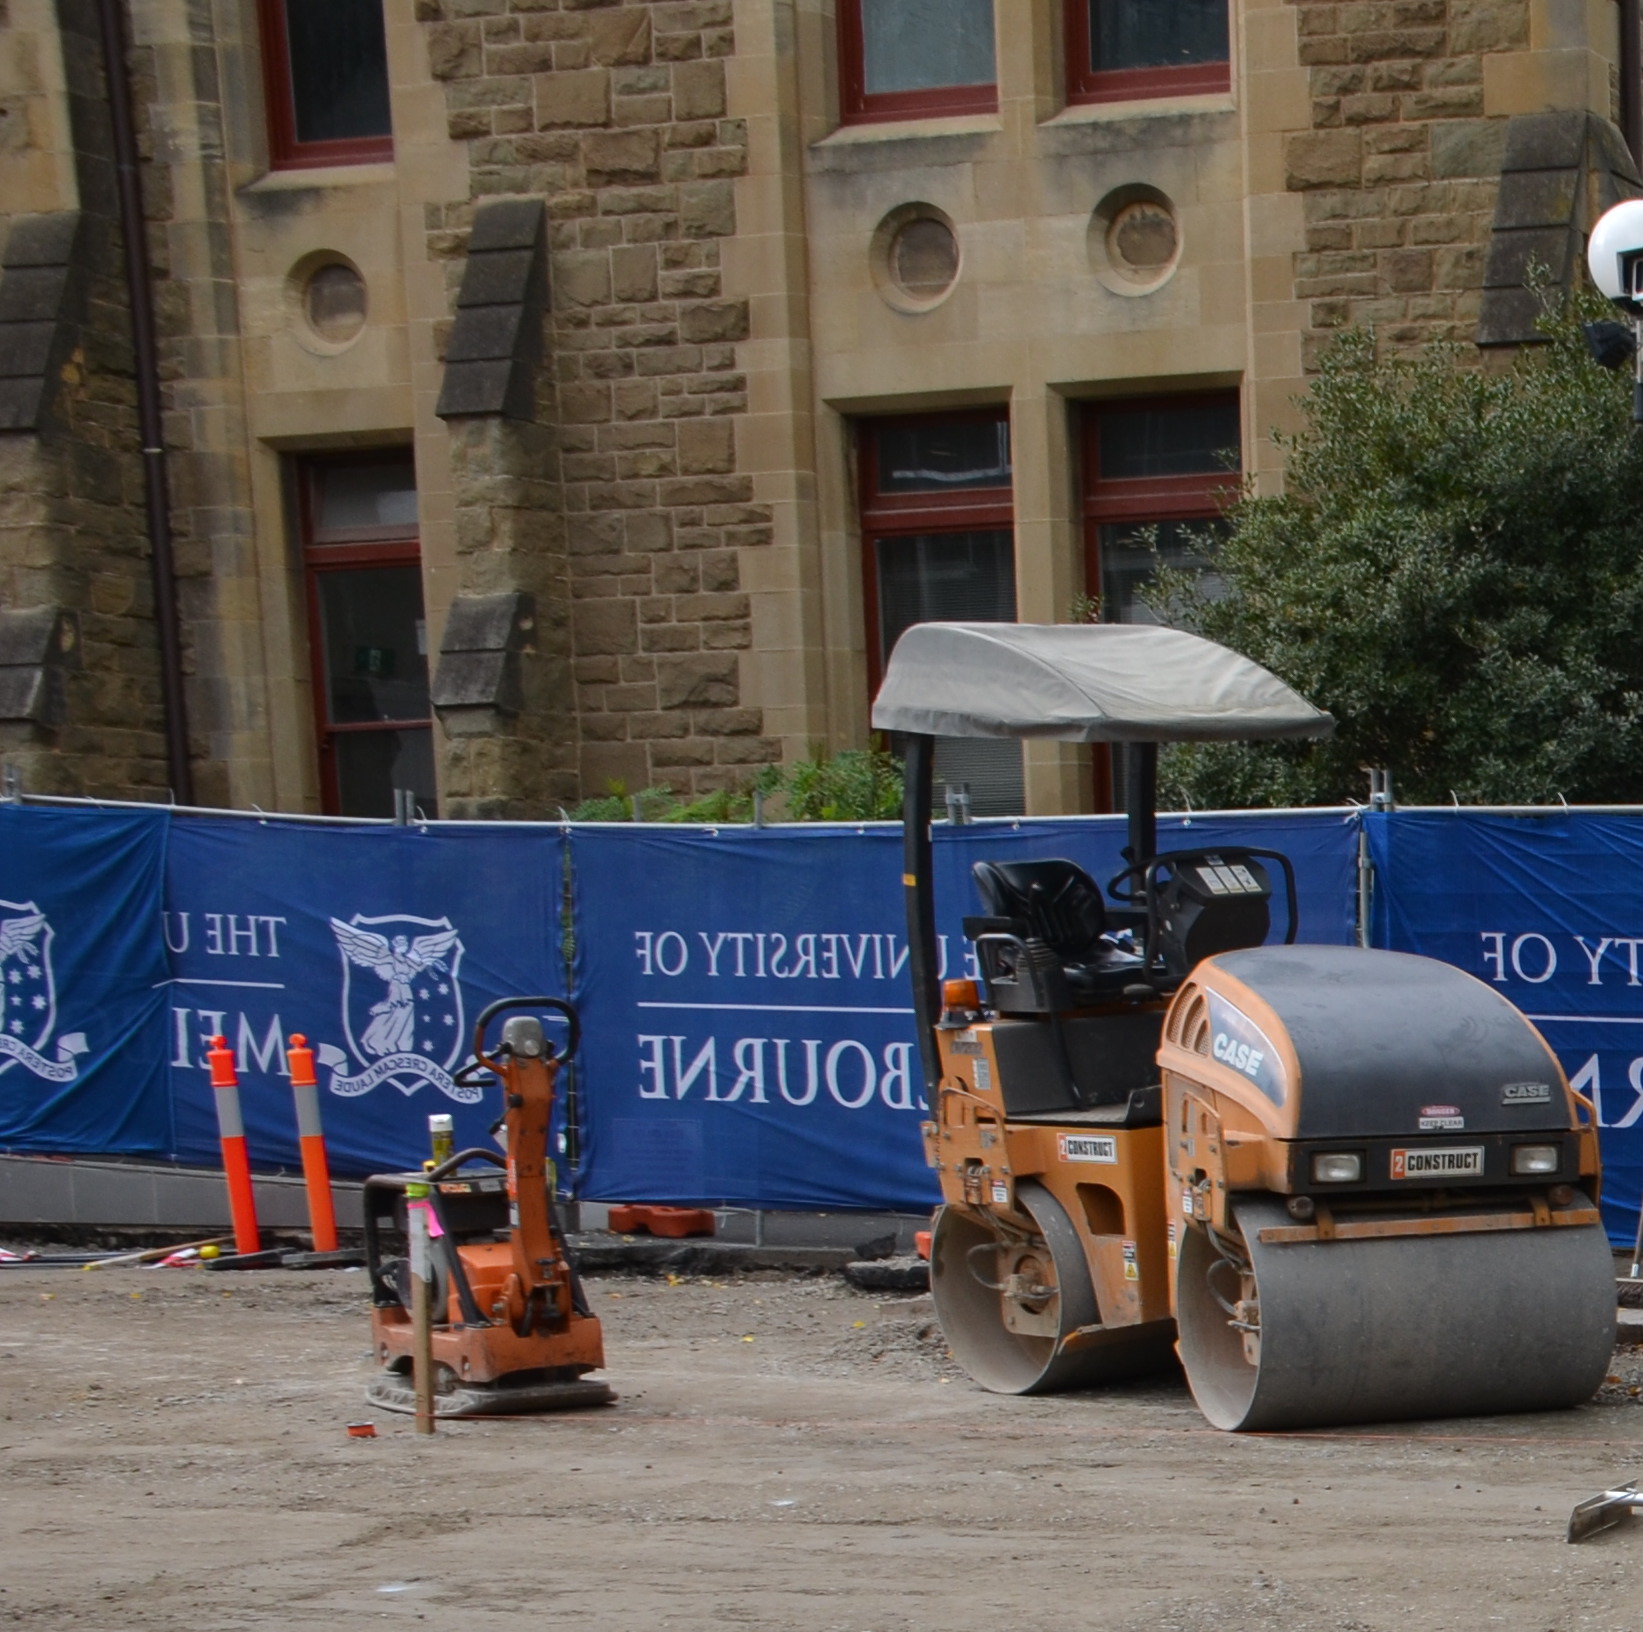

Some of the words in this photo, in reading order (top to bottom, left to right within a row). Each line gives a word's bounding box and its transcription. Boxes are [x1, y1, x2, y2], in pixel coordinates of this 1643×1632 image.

[1213, 1033, 1264, 1077] CASE
[1504, 1084, 1550, 1098] CASE
[1440, 1119, 1463, 1127] CLEAR
[1067, 1139, 1113, 1157] CONSTRUCT
[1395, 1155, 1404, 1173] 2
[1407, 1152, 1479, 1171] CONSTRUCT
